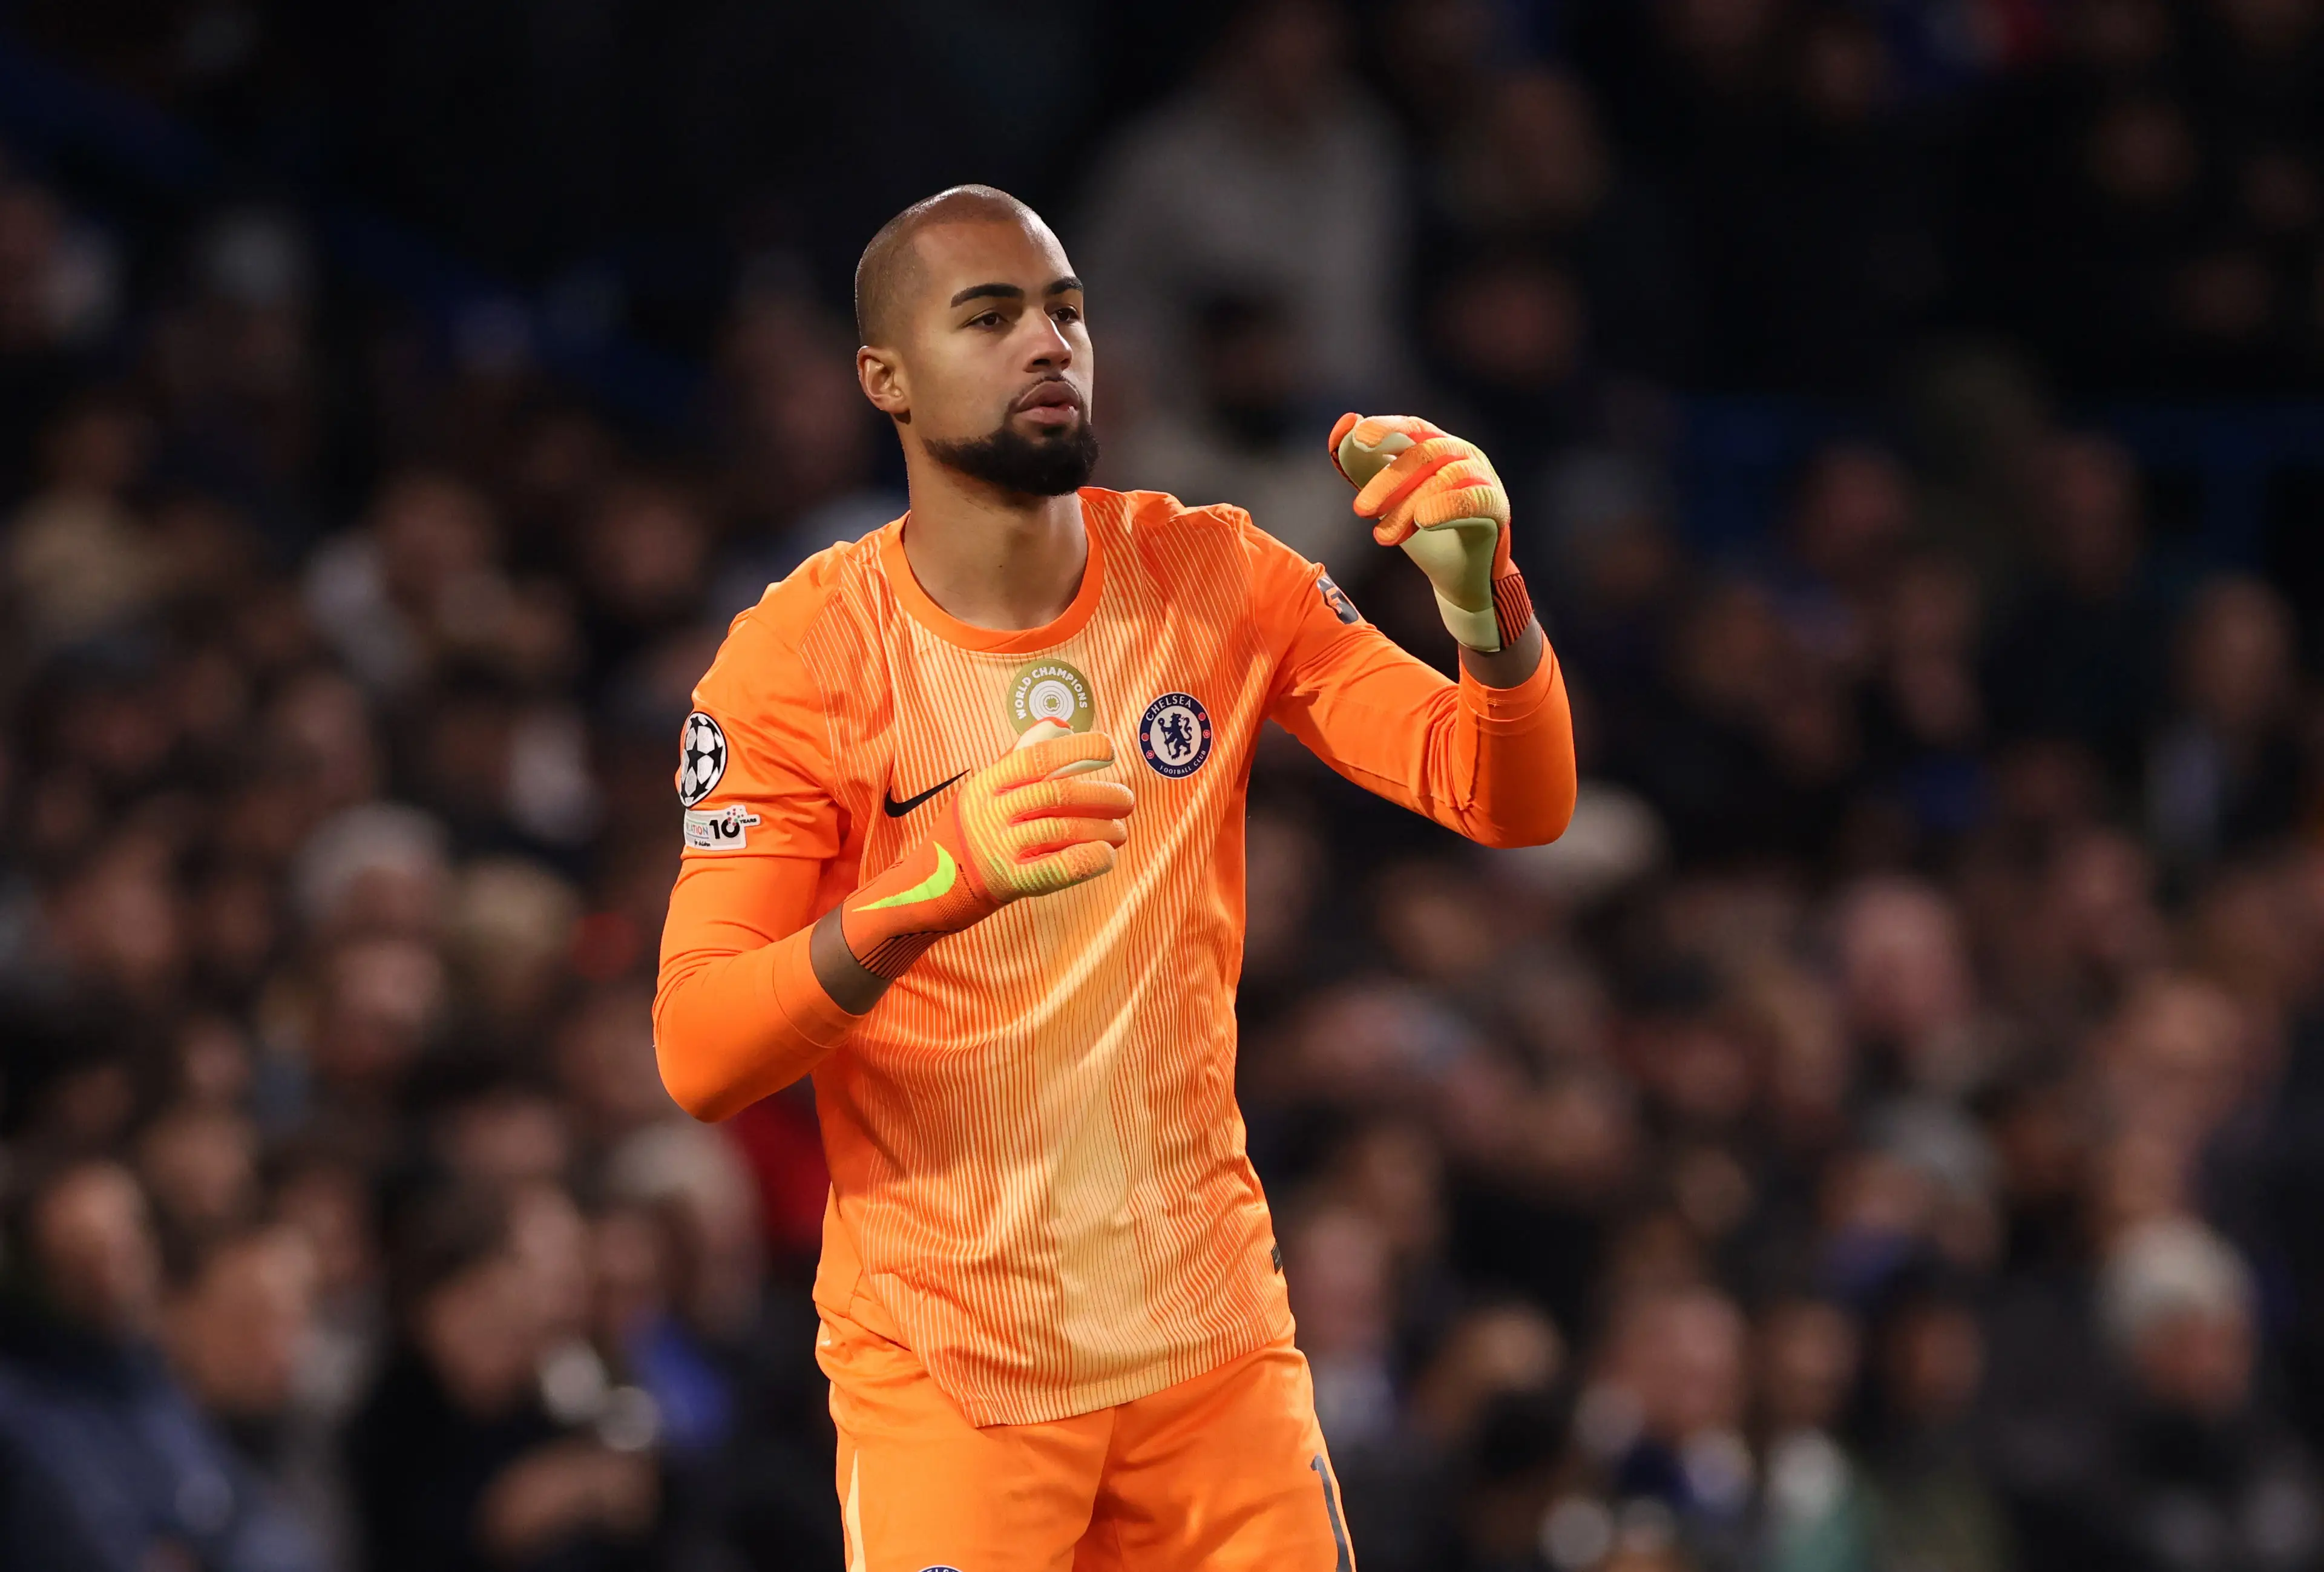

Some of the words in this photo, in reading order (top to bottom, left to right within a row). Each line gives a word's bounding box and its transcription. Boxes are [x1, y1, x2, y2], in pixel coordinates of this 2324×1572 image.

[1015, 677, 1031, 720] WORLD
[1031, 666, 1088, 709] CHAMPIONS
[1146, 695, 1192, 721] CHELSEA
[1160, 765, 1192, 775] FOOTBALL
[1193, 750, 1206, 766] CLUB
[709, 818, 740, 840] 10
